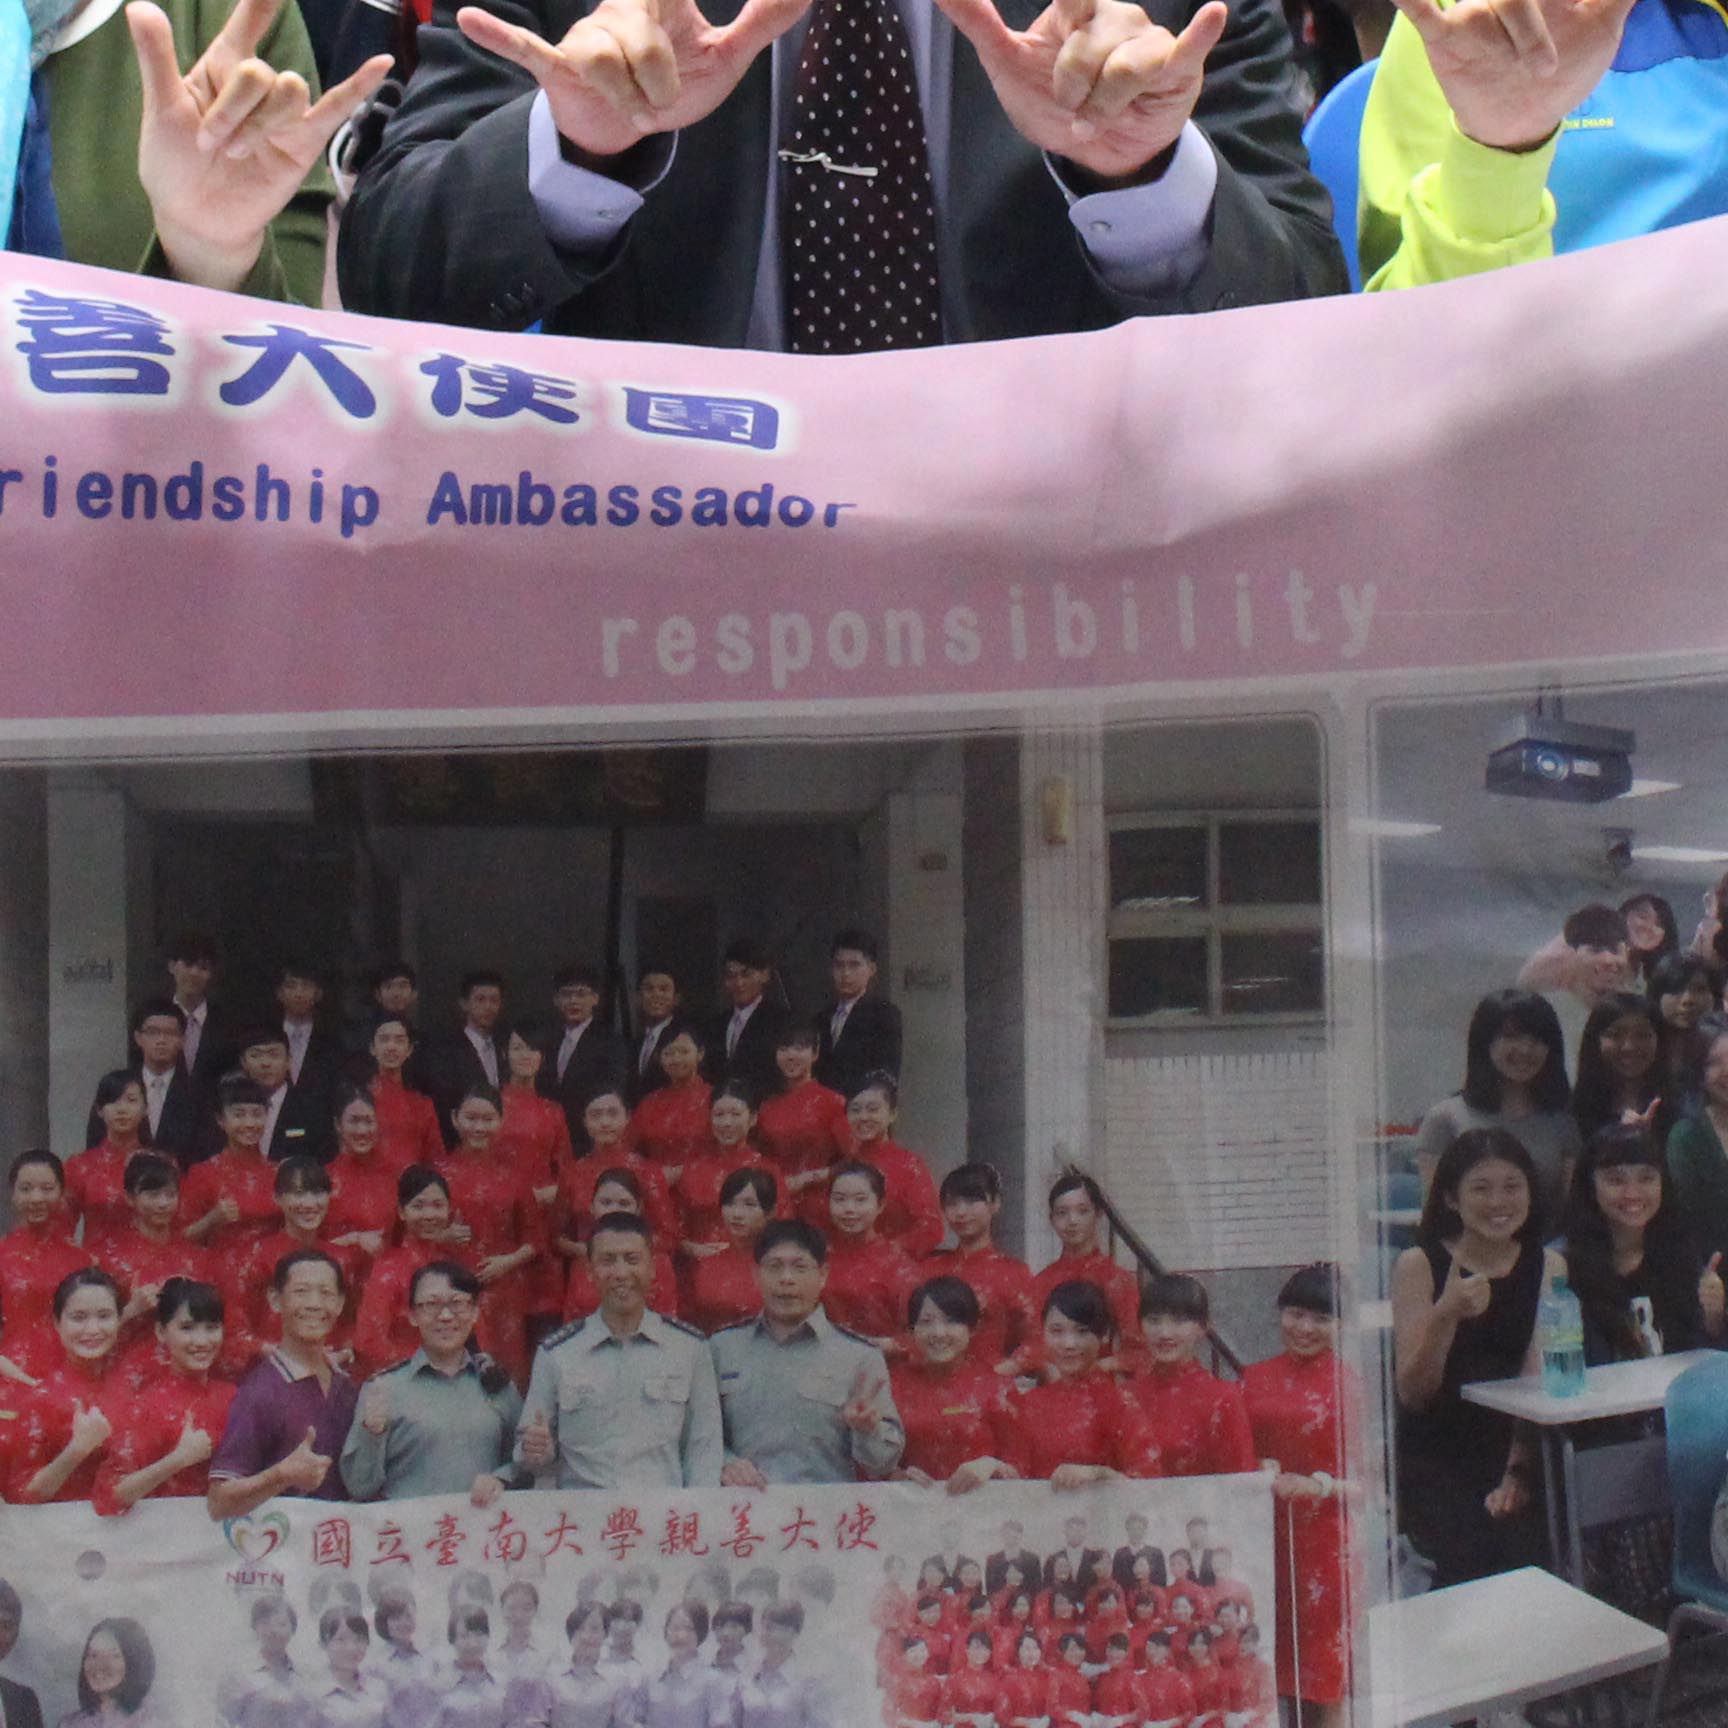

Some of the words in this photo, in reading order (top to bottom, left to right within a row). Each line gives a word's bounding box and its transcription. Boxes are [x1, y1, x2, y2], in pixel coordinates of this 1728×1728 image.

[426, 471, 857, 529] Ambassador
[599, 568, 1378, 690] responsibility
[310, 1502, 881, 1571] 國立臺南大學親善大使
[226, 1570, 285, 1588] NUTN
